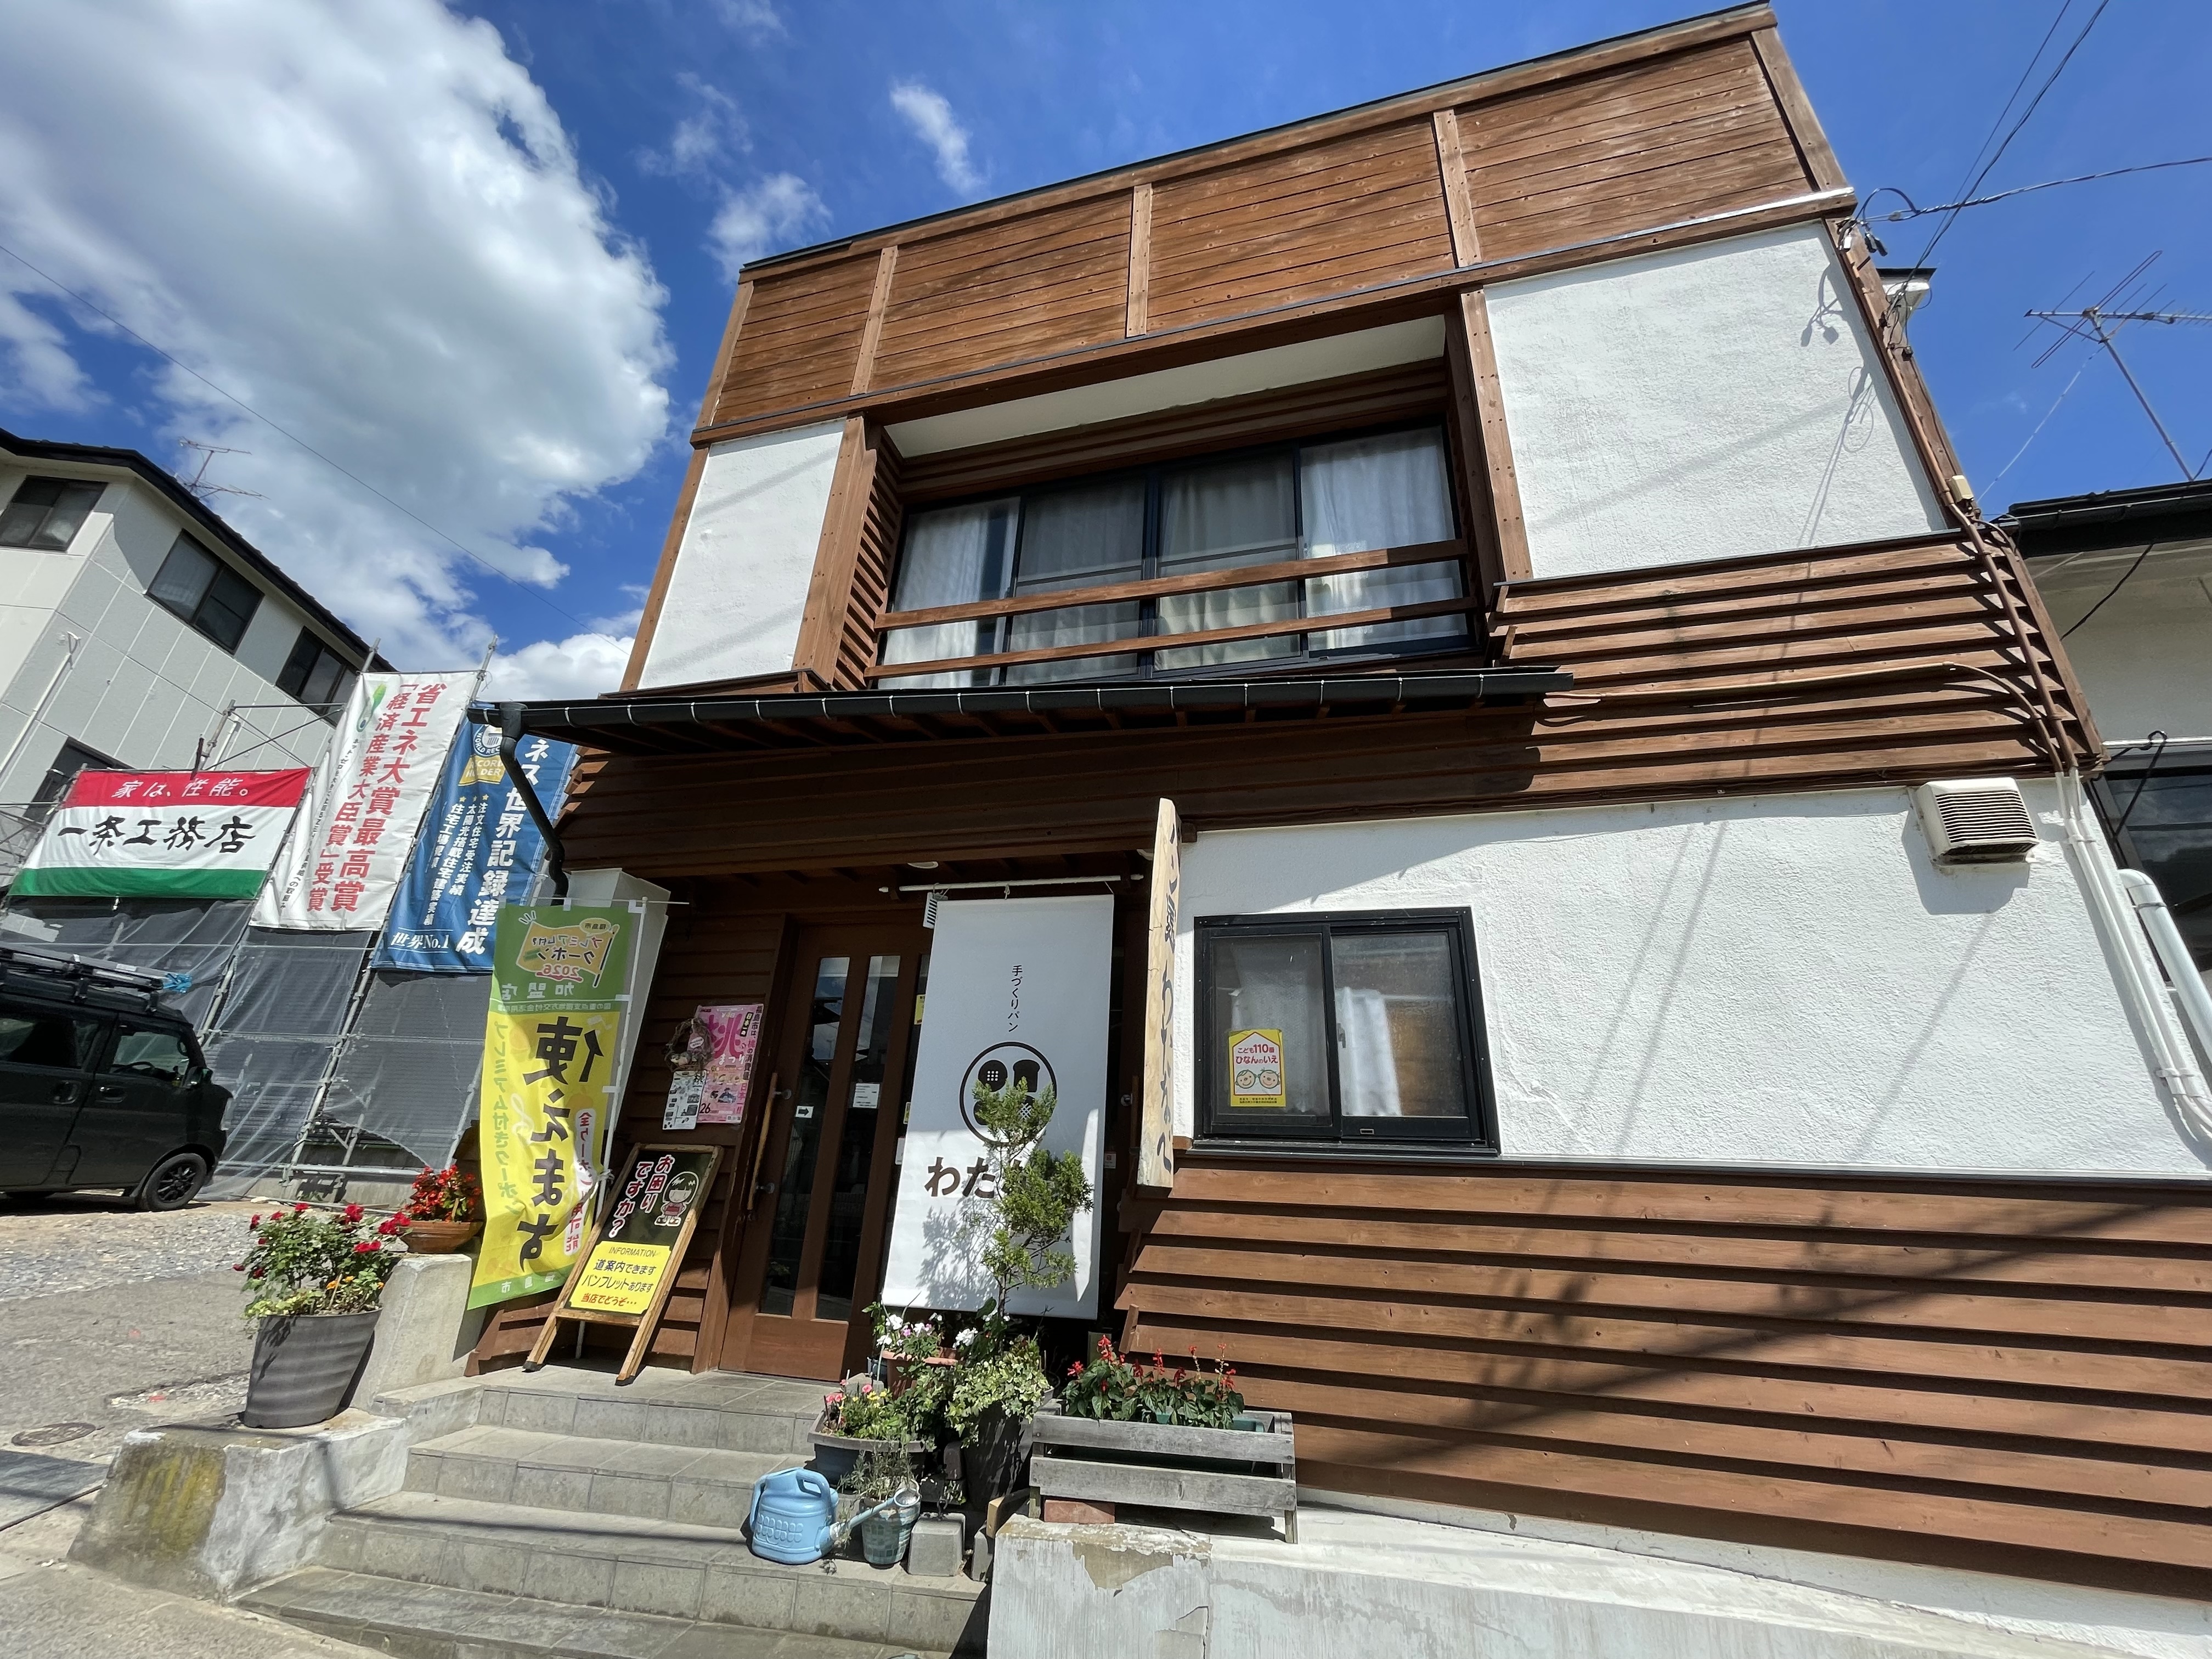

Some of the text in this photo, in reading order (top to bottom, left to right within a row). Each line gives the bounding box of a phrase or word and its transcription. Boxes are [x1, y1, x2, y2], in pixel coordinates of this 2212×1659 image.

[475, 731, 486, 753] WORLD
[111, 777, 250, 799] 家は、性能。
[307, 684, 419, 912] 「経済産業大臣賞」受賞
[331, 683, 447, 912] 省エネ大賞最高賞
[58, 816, 256, 855] 一条工務店
[448, 802, 489, 896] 注文住宅受注実績
[391, 932, 449, 949] 世界No.1
[1008, 964, 1023, 1032] 手づくりパン
[1235, 1055, 1279, 1064] ひなんのいえ
[640, 1154, 675, 1214] お困り
[608, 1161, 654, 1238] ですか？
[608, 1246, 657, 1257] INFORMATION
[592, 1259, 657, 1276] 道案内できます
[581, 1274, 654, 1293] パンフレットあります
